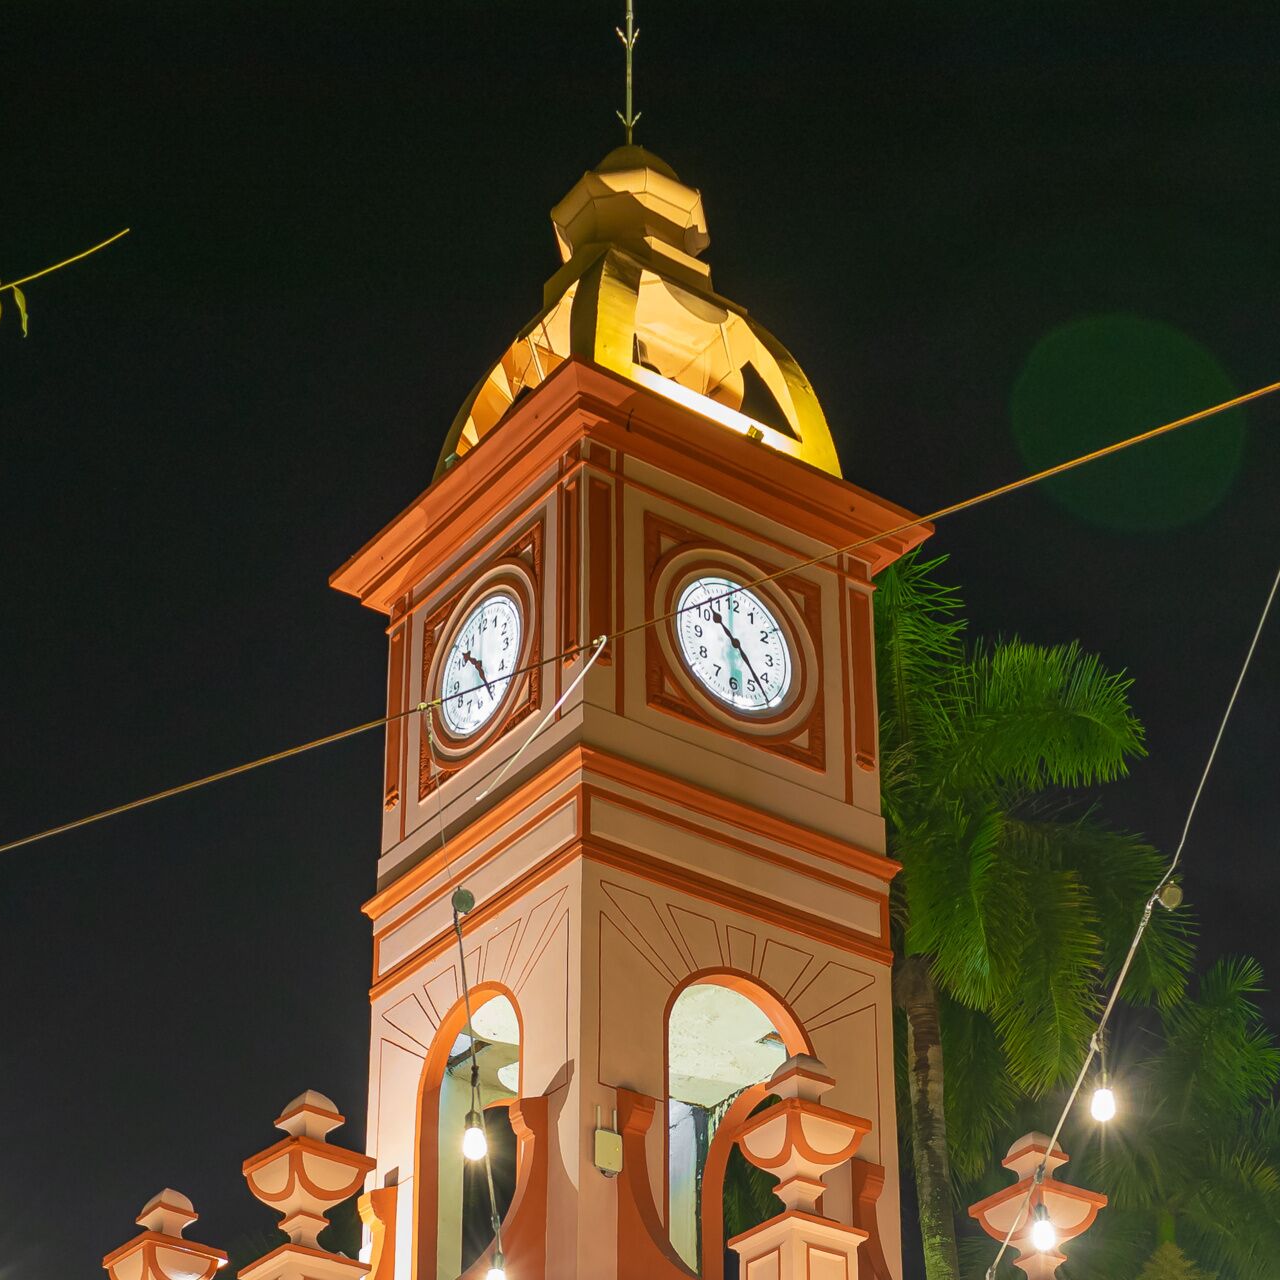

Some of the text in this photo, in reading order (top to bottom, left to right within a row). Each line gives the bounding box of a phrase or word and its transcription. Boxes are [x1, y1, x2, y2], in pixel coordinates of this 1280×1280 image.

[725, 597, 740, 614] 12
[696, 605, 711, 621] 10
[747, 612, 755, 625] 1
[478, 618, 488, 635] 12
[492, 615, 498, 628] 1
[501, 622, 507, 636] 2
[694, 624, 703, 638] 9
[465, 634, 475, 651] 11
[503, 637, 509, 651] 3
[760, 630, 770, 644] 2
[699, 645, 708, 659] 8
[498, 658, 505, 672] 4
[765, 654, 774, 668] 3
[712, 663, 722, 677] 7
[729, 677, 738, 690] 6
[746, 678, 756, 692] 5
[760, 672, 769, 684] 4
[453, 680, 460, 695] 9
[457, 694, 464, 708] 8
[466, 699, 473, 713] 7
